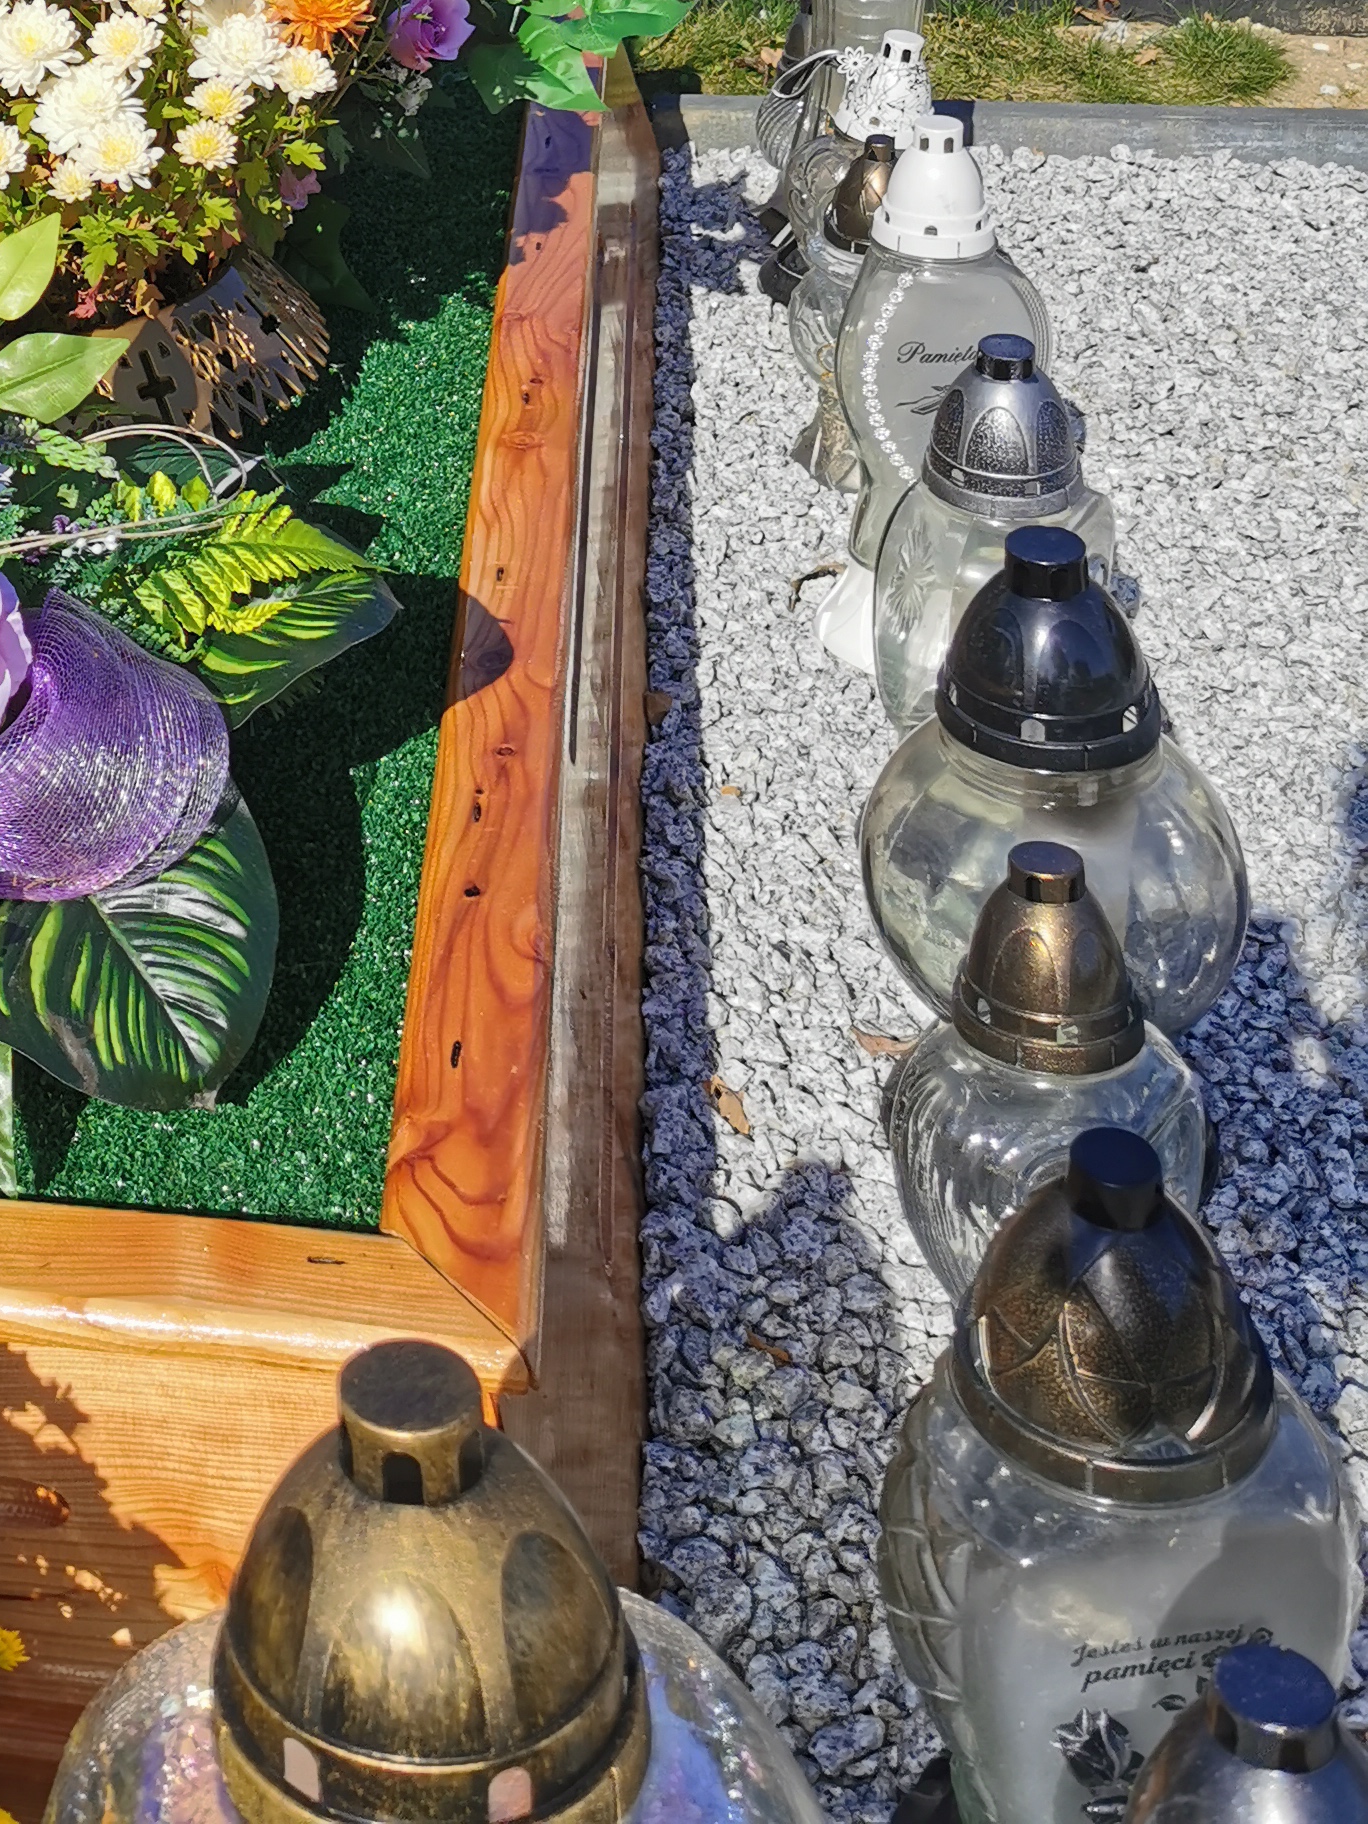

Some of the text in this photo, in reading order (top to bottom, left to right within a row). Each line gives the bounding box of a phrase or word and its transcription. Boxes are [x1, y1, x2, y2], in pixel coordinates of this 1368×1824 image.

[1150, 1637, 1171, 1649] w
[1175, 1623, 1245, 1646] naszej
[1080, 1651, 1197, 1693] pamięci
